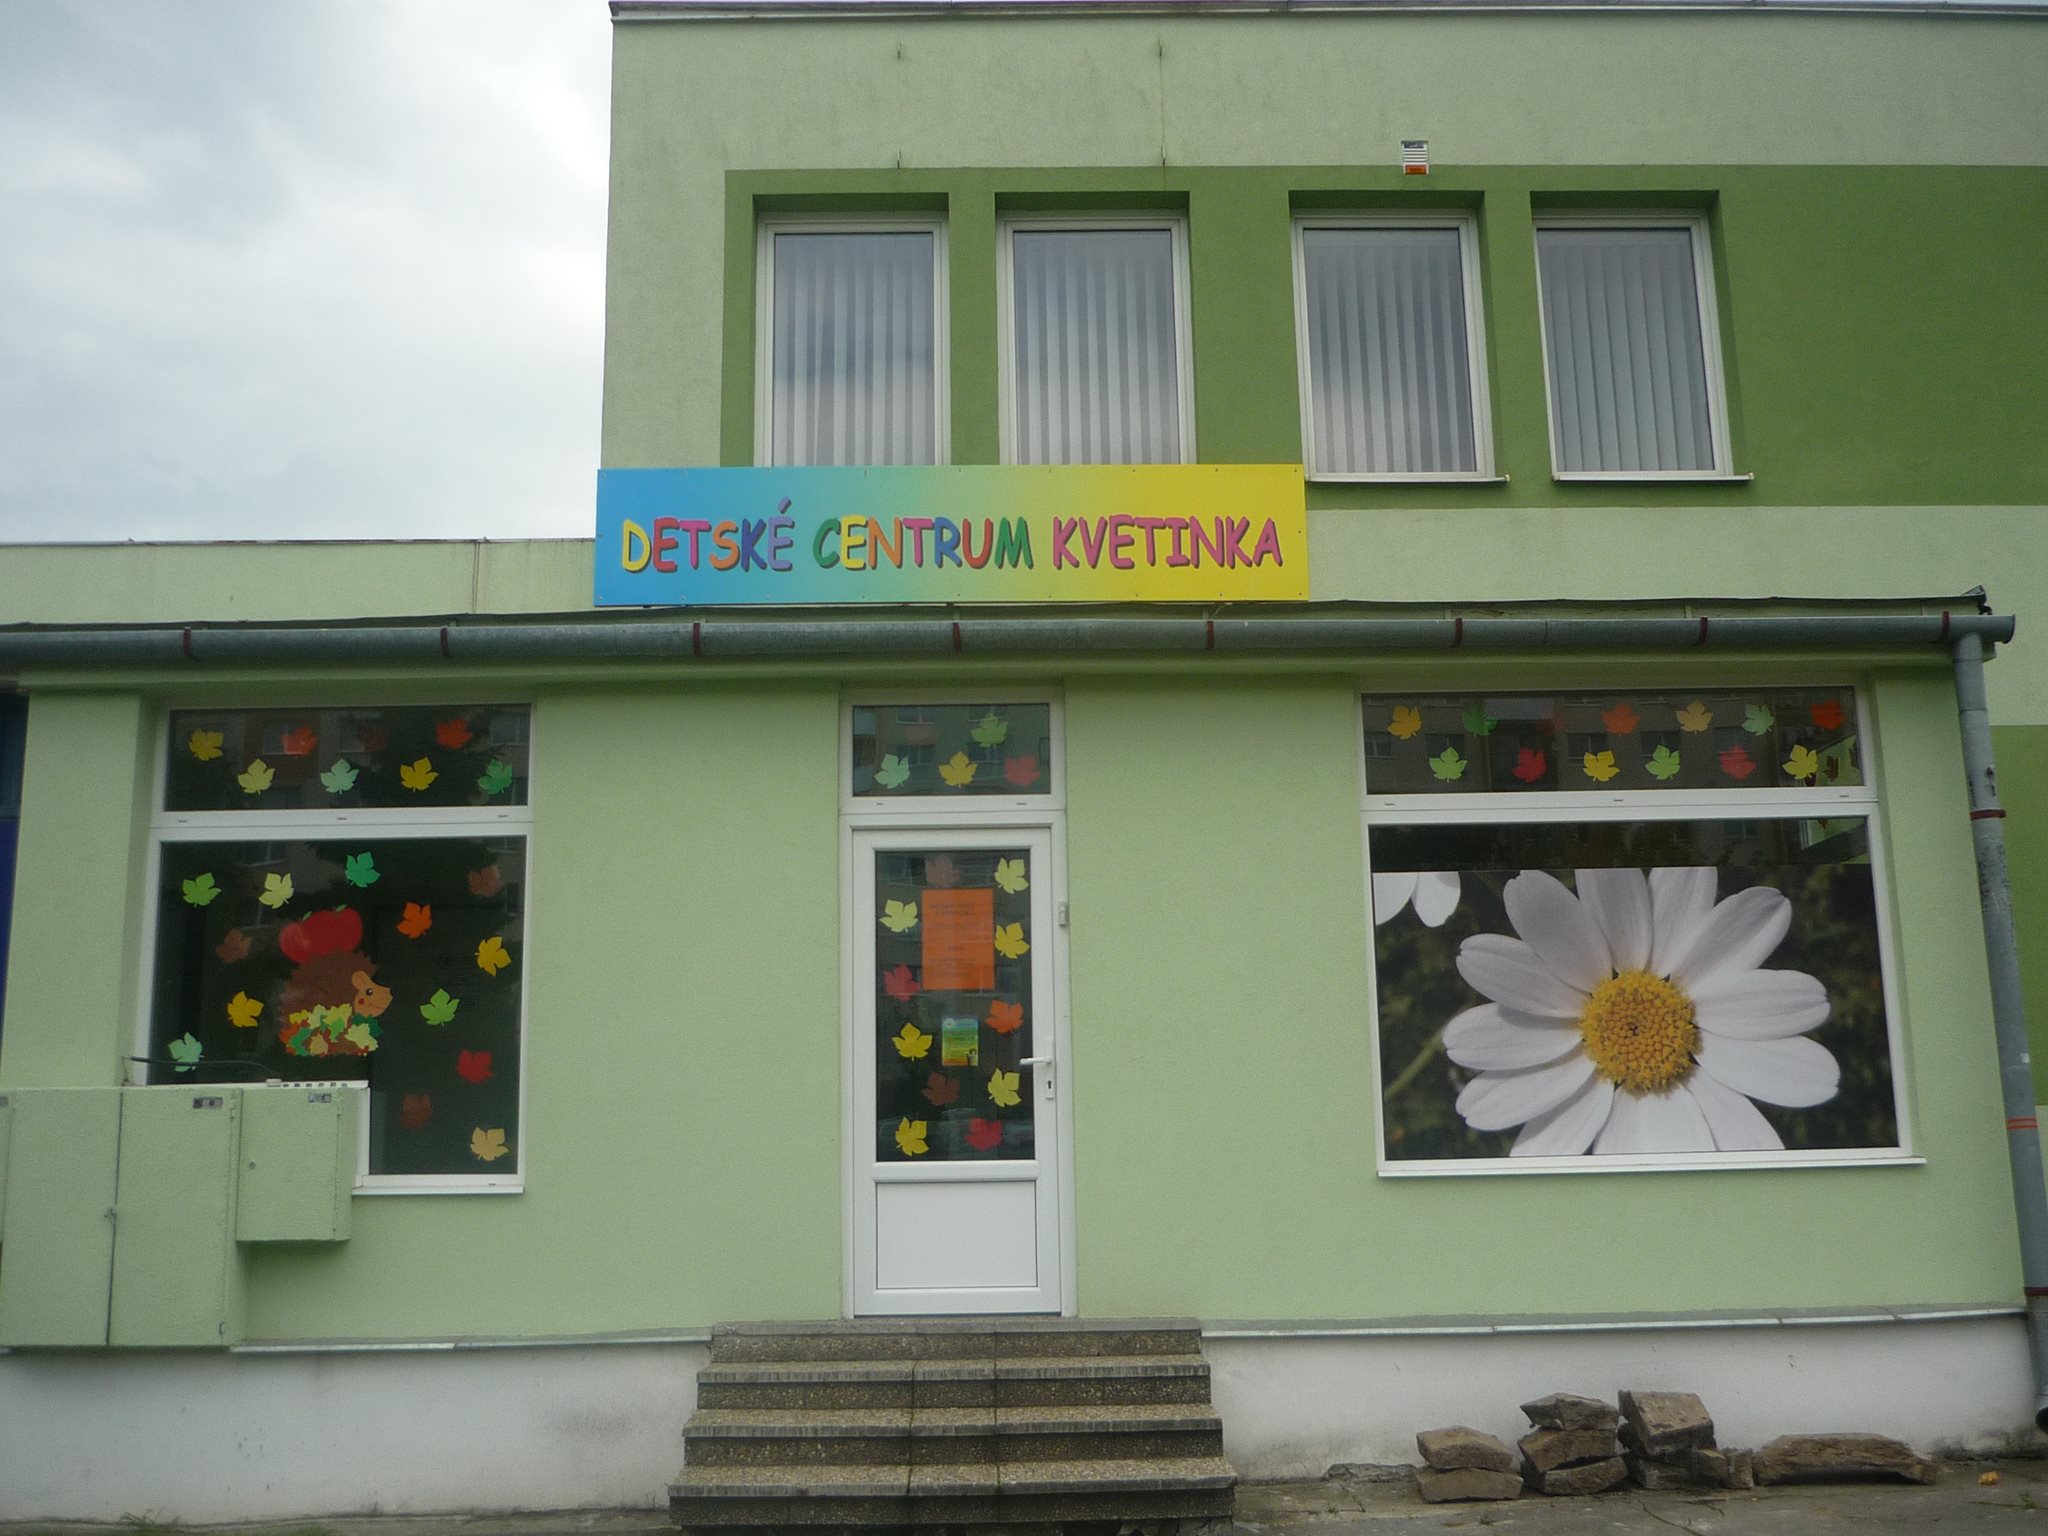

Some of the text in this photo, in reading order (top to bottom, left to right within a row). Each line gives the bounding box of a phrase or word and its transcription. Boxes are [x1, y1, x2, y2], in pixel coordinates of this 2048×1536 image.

[622, 498, 1283, 573] DETSKÉ CENTRUM KVETINKA
